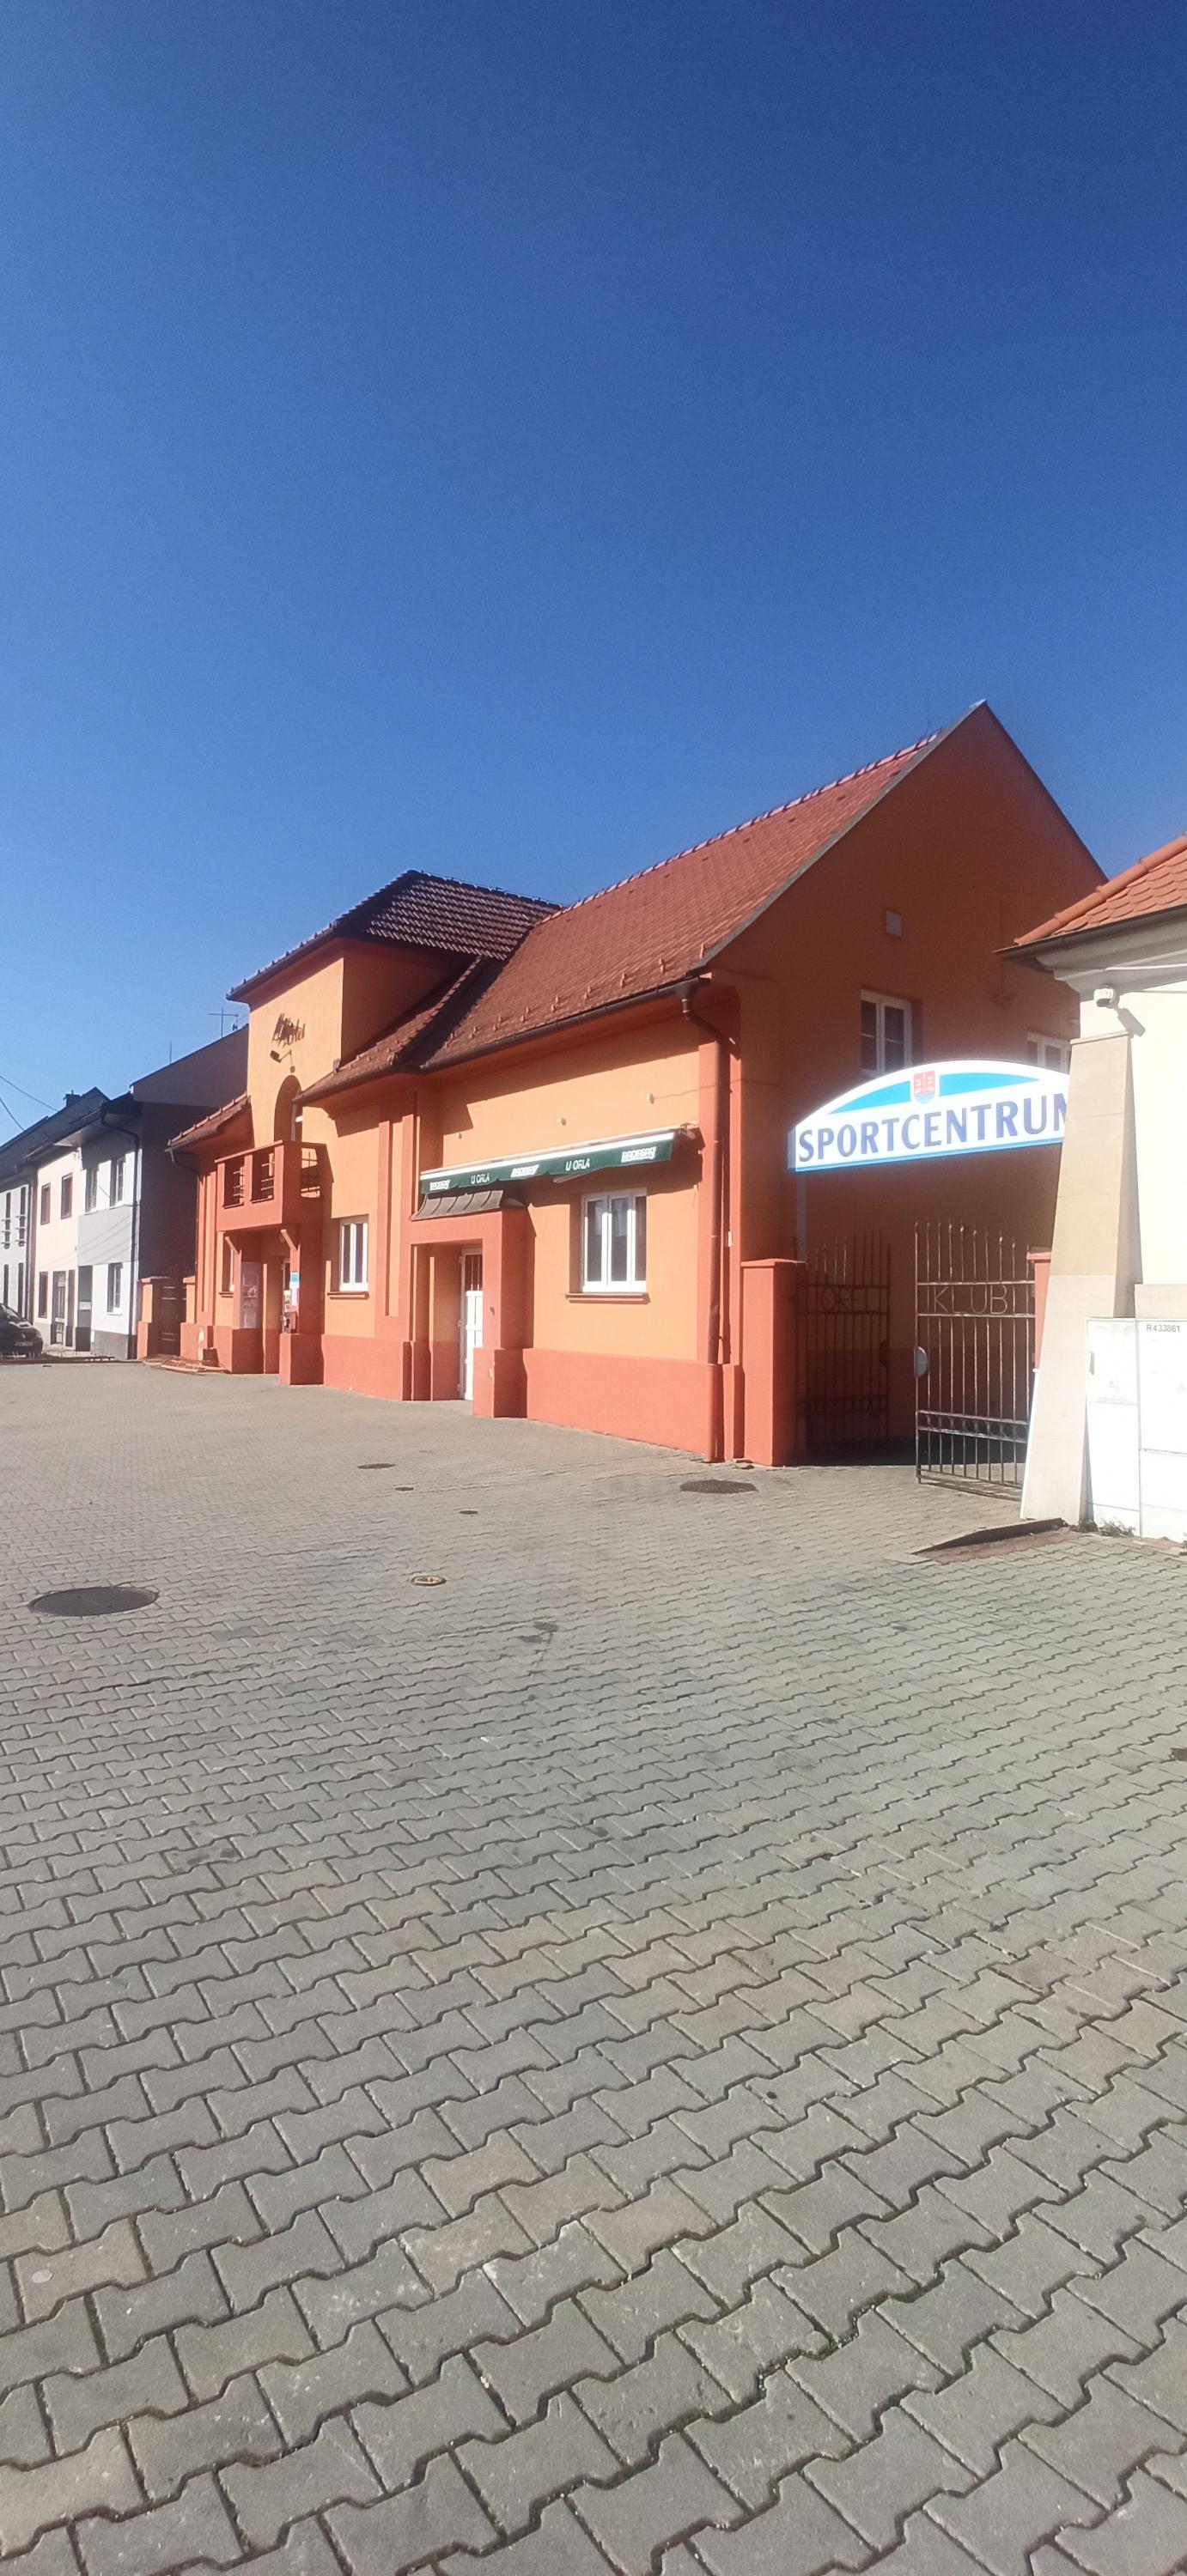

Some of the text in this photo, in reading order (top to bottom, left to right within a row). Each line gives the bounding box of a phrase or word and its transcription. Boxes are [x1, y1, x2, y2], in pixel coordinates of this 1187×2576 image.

[565, 1157, 590, 1171] U ORLA
[934, 1284, 1008, 1315] KLUB
